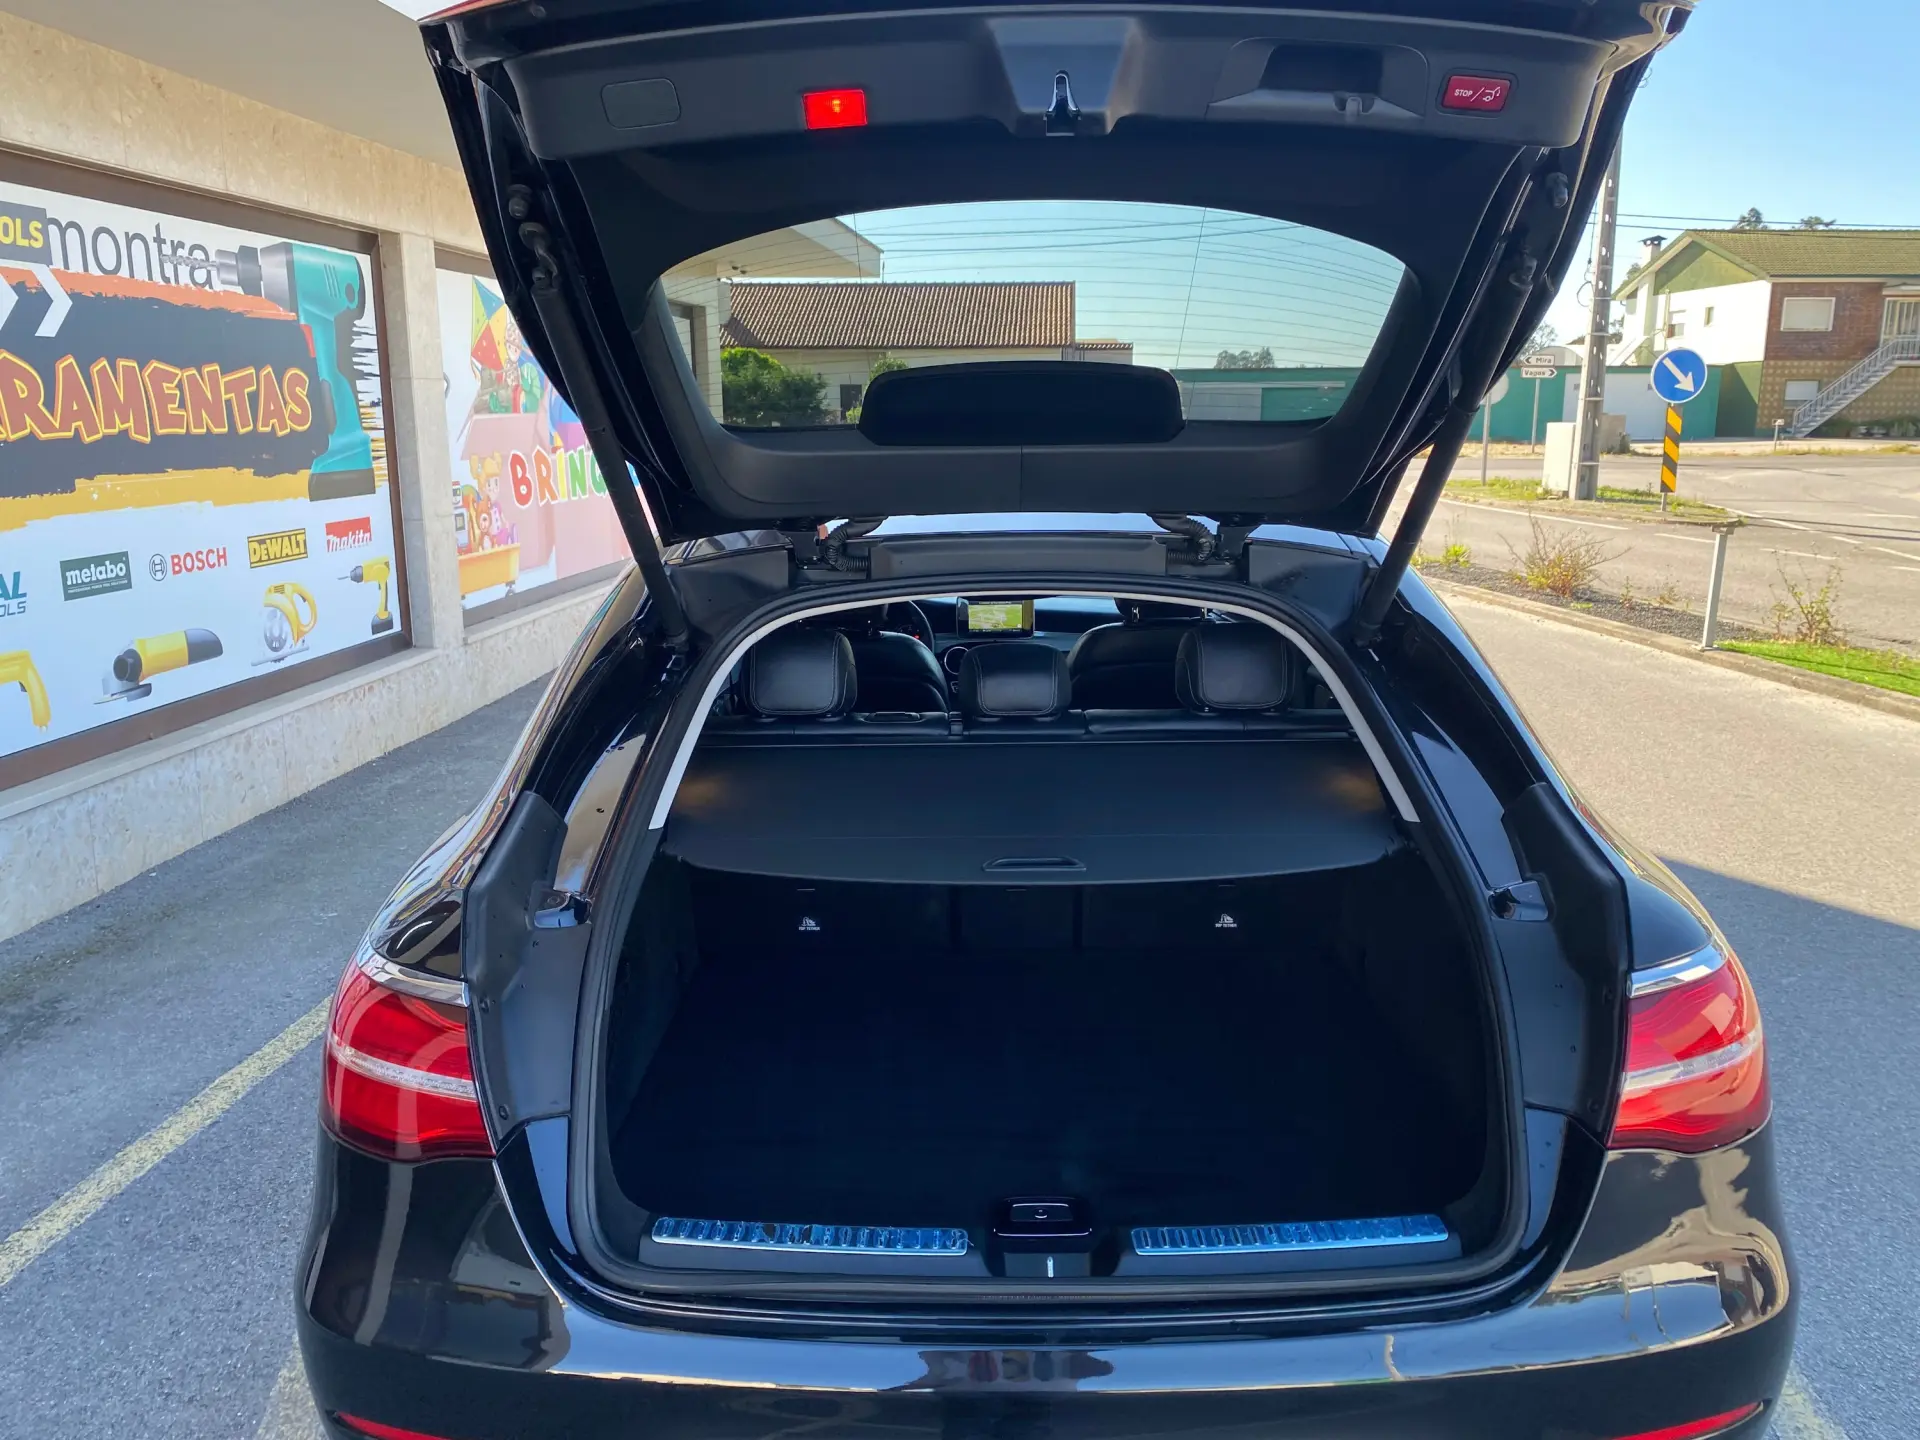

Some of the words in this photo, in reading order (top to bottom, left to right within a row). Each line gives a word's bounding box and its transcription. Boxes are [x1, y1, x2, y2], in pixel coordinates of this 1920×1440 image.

[1454, 89, 1472, 97] STOP
[0, 216, 44, 248] OLS
[47, 216, 214, 289] montra
[0, 349, 312, 444] RAMENTAS
[65, 560, 126, 586] metabo
[170, 546, 228, 576] BOSCH
